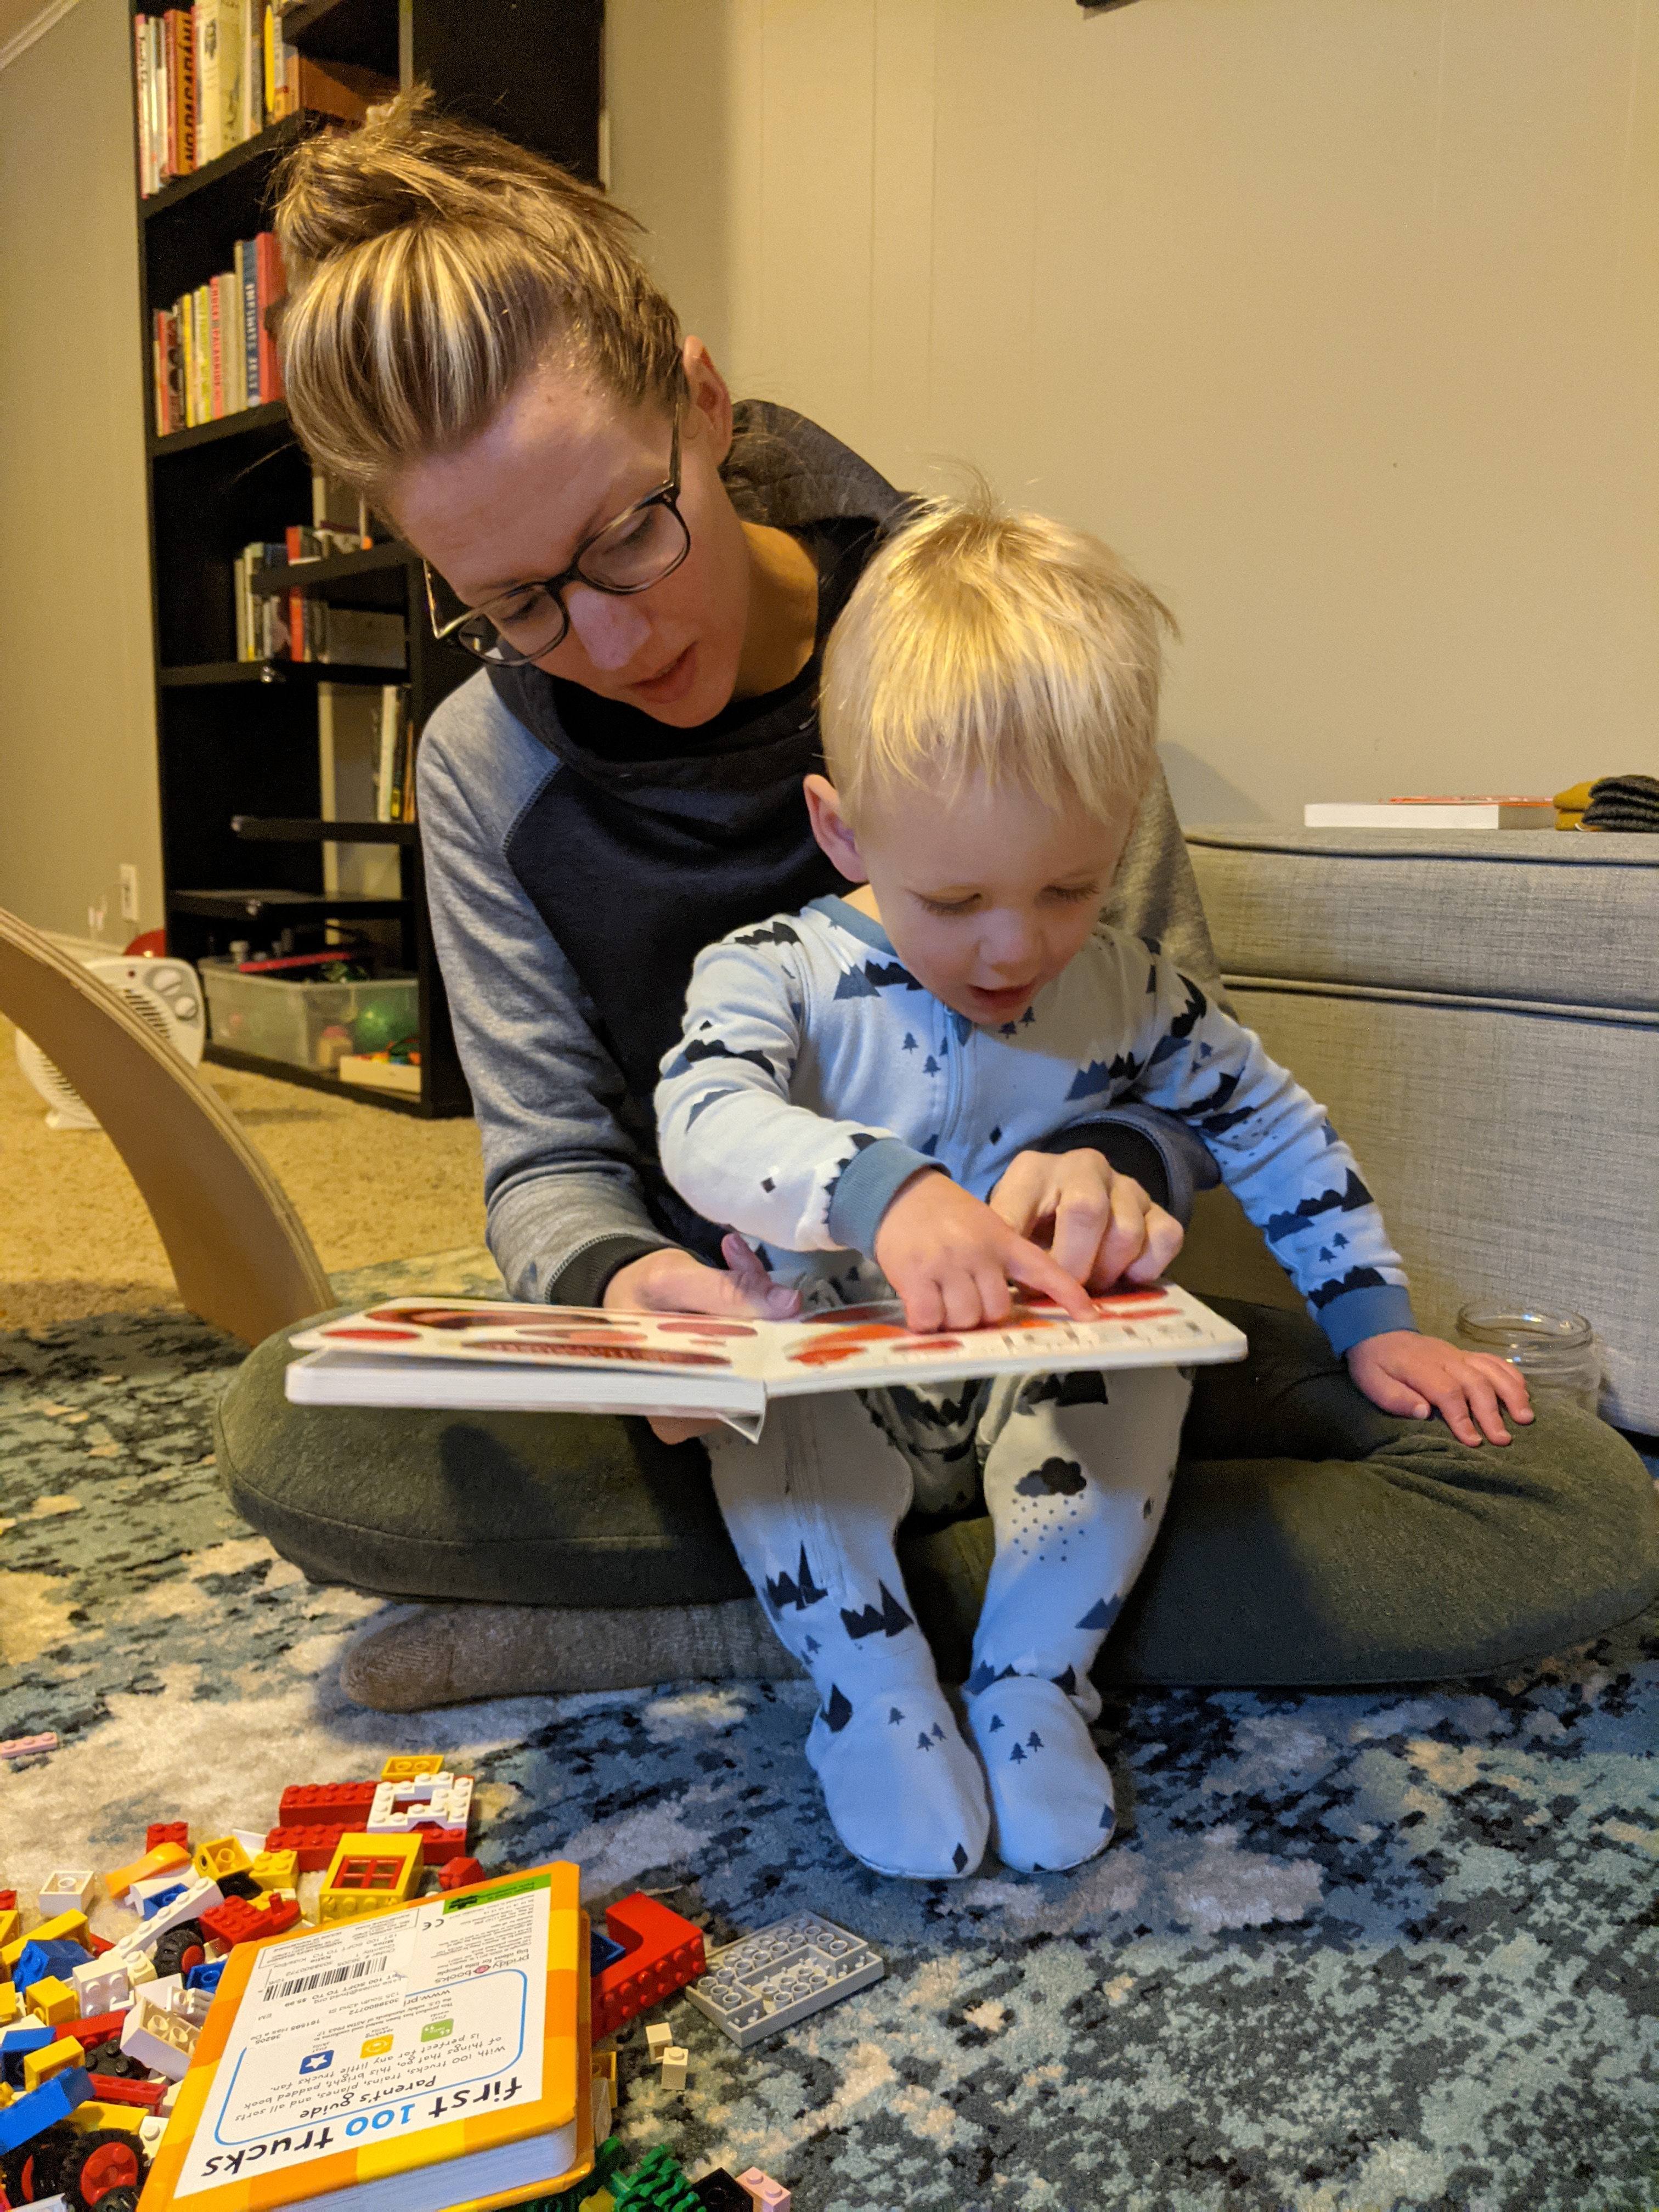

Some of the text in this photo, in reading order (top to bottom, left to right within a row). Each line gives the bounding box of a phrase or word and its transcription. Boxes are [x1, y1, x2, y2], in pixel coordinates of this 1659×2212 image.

[437, 1965, 462, 1975] people
[435, 1970, 471, 1983] books
[343, 1982, 365, 1991] SOFT
[403, 1989, 450, 2006] www.pri
[375, 2009, 405, 2019] standards
[415, 2005, 439, 2015] product
[365, 2020, 383, 2028] tested
[321, 2029, 349, 2039] conforms
[365, 2028, 393, 2038] speaking
[421, 2035, 465, 2053] perfect
[398, 2049, 416, 2058] for
[373, 2056, 393, 2064] any
[244, 2036, 501, 2109] of things that go, this bright, padded book
[340, 2061, 368, 2074] little
[298, 2071, 334, 2084] trucks
[235, 2046, 505, 2120] With 100 trucks, trains, planes, and all sorts
[270, 2082, 292, 2090] fan.
[300, 2075, 436, 2118] Parent's guide
[202, 2076, 521, 2176] first 100 trucks
